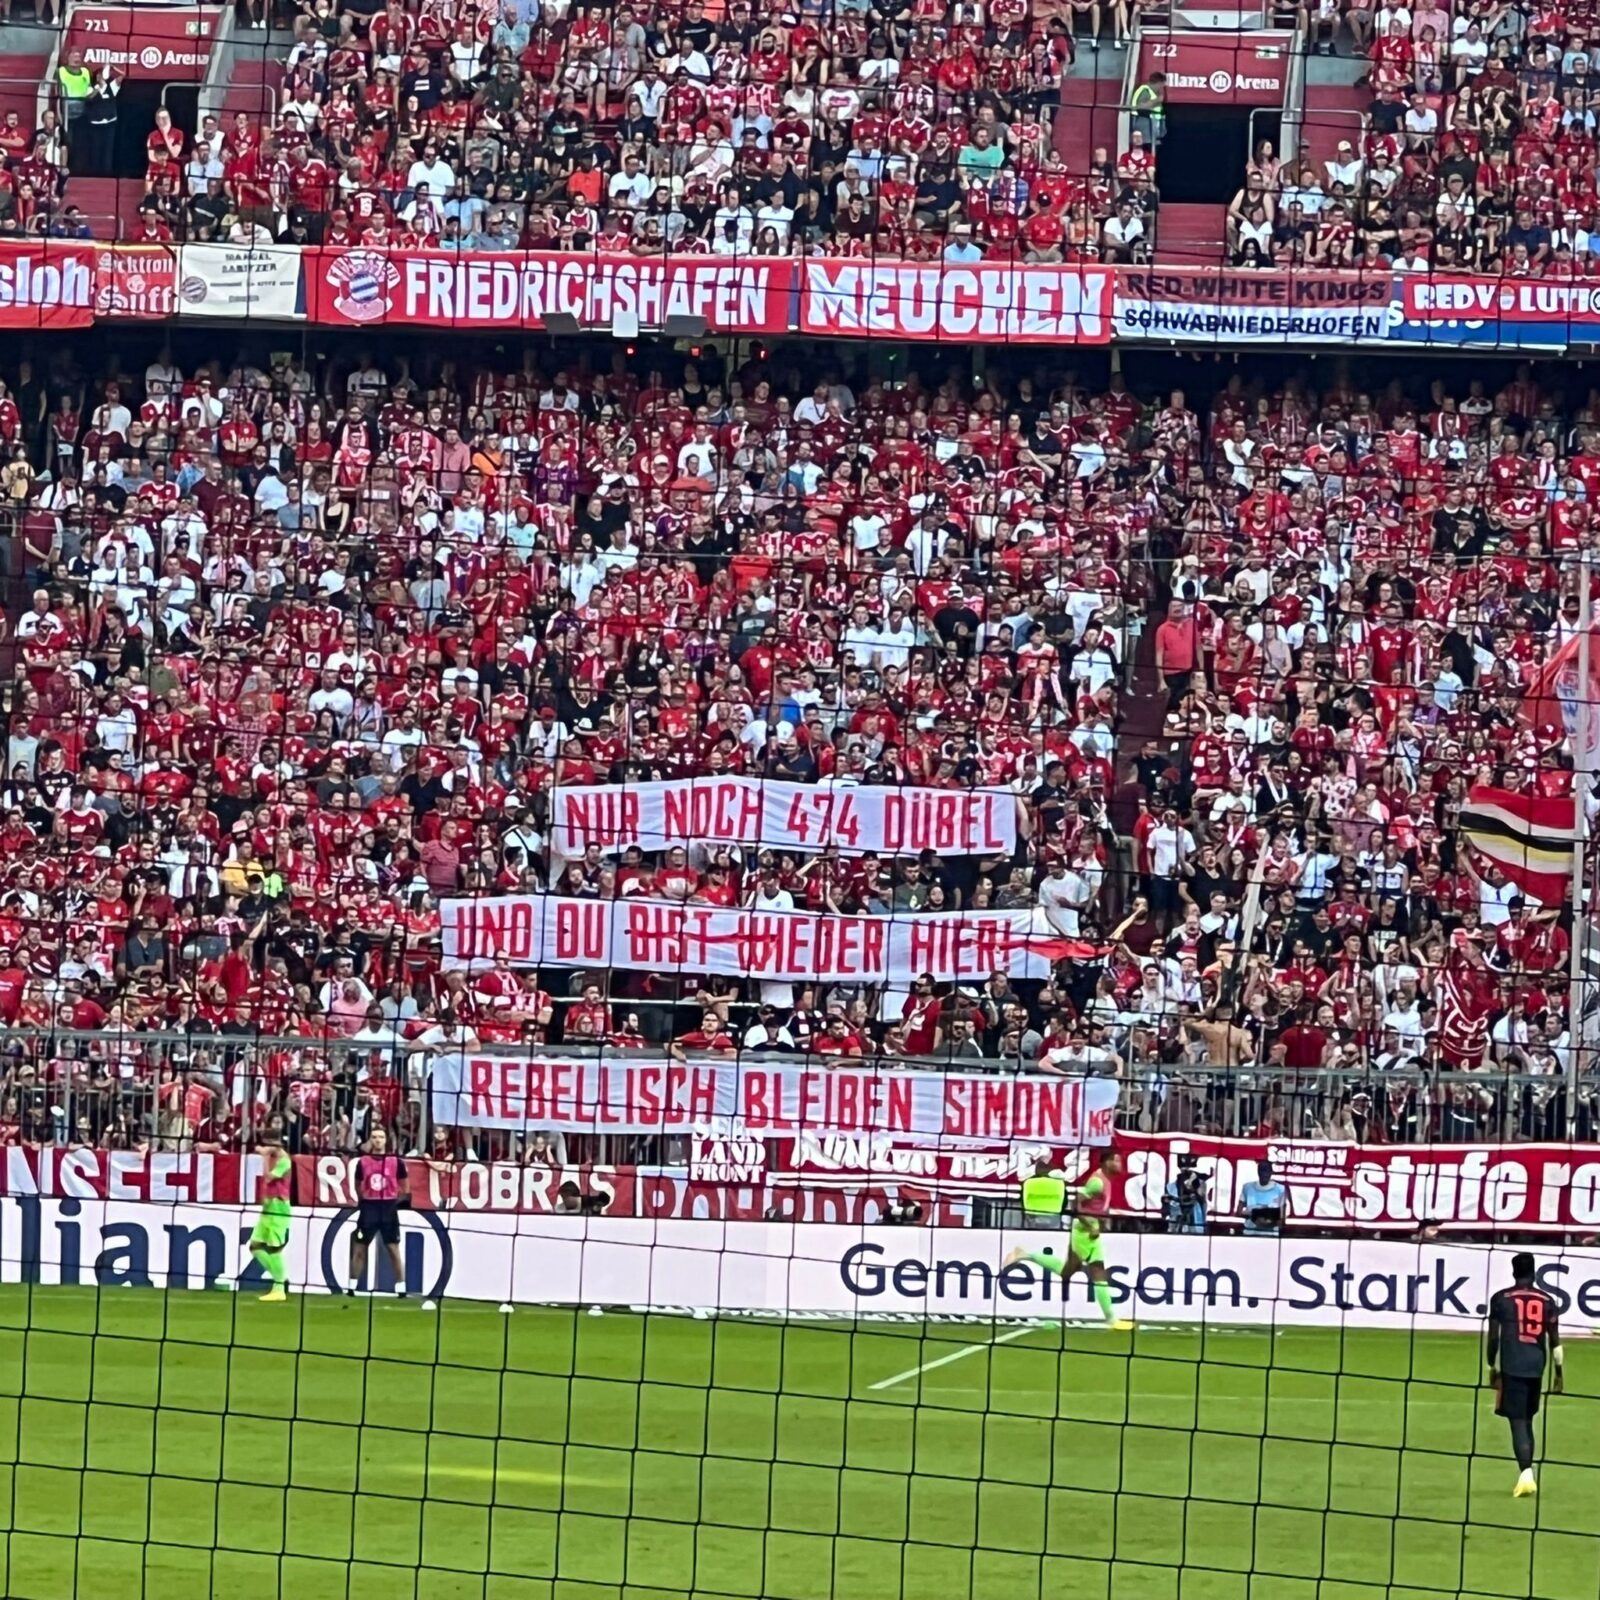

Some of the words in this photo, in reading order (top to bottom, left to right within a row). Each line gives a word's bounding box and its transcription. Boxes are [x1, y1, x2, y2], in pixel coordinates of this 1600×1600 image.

[83, 48, 138, 64] Allianz
[164, 50, 210, 65] Arena
[1235, 73, 1280, 90] Arena
[405, 257, 768, 325] FRIEDRICHSHAFEN
[806, 262, 1106, 336] MEUCHEN
[1298, 280, 1386, 301] KINGS
[1124, 308, 1381, 336] SCHWABNIEDERHOFEN
[566, 791, 639, 848] NUR
[664, 783, 765, 843] NOCH
[786, 792, 860, 846] 474
[883, 792, 1004, 849] DÜBEL
[456, 902, 533, 960] UND
[556, 903, 607, 960] DU
[628, 904, 713, 965] BIST
[737, 914, 884, 974] WIEDER
[470, 1060, 717, 1126] REBELLISCH
[743, 1071, 913, 1133] BLEIBEN
[944, 1078, 1081, 1138] SIMON!
[691, 1141, 766, 1165] LAND
[690, 1164, 765, 1184] FRONT
[1289, 1255, 1489, 1315] Stark.
[1514, 1298, 1544, 1336] 19
